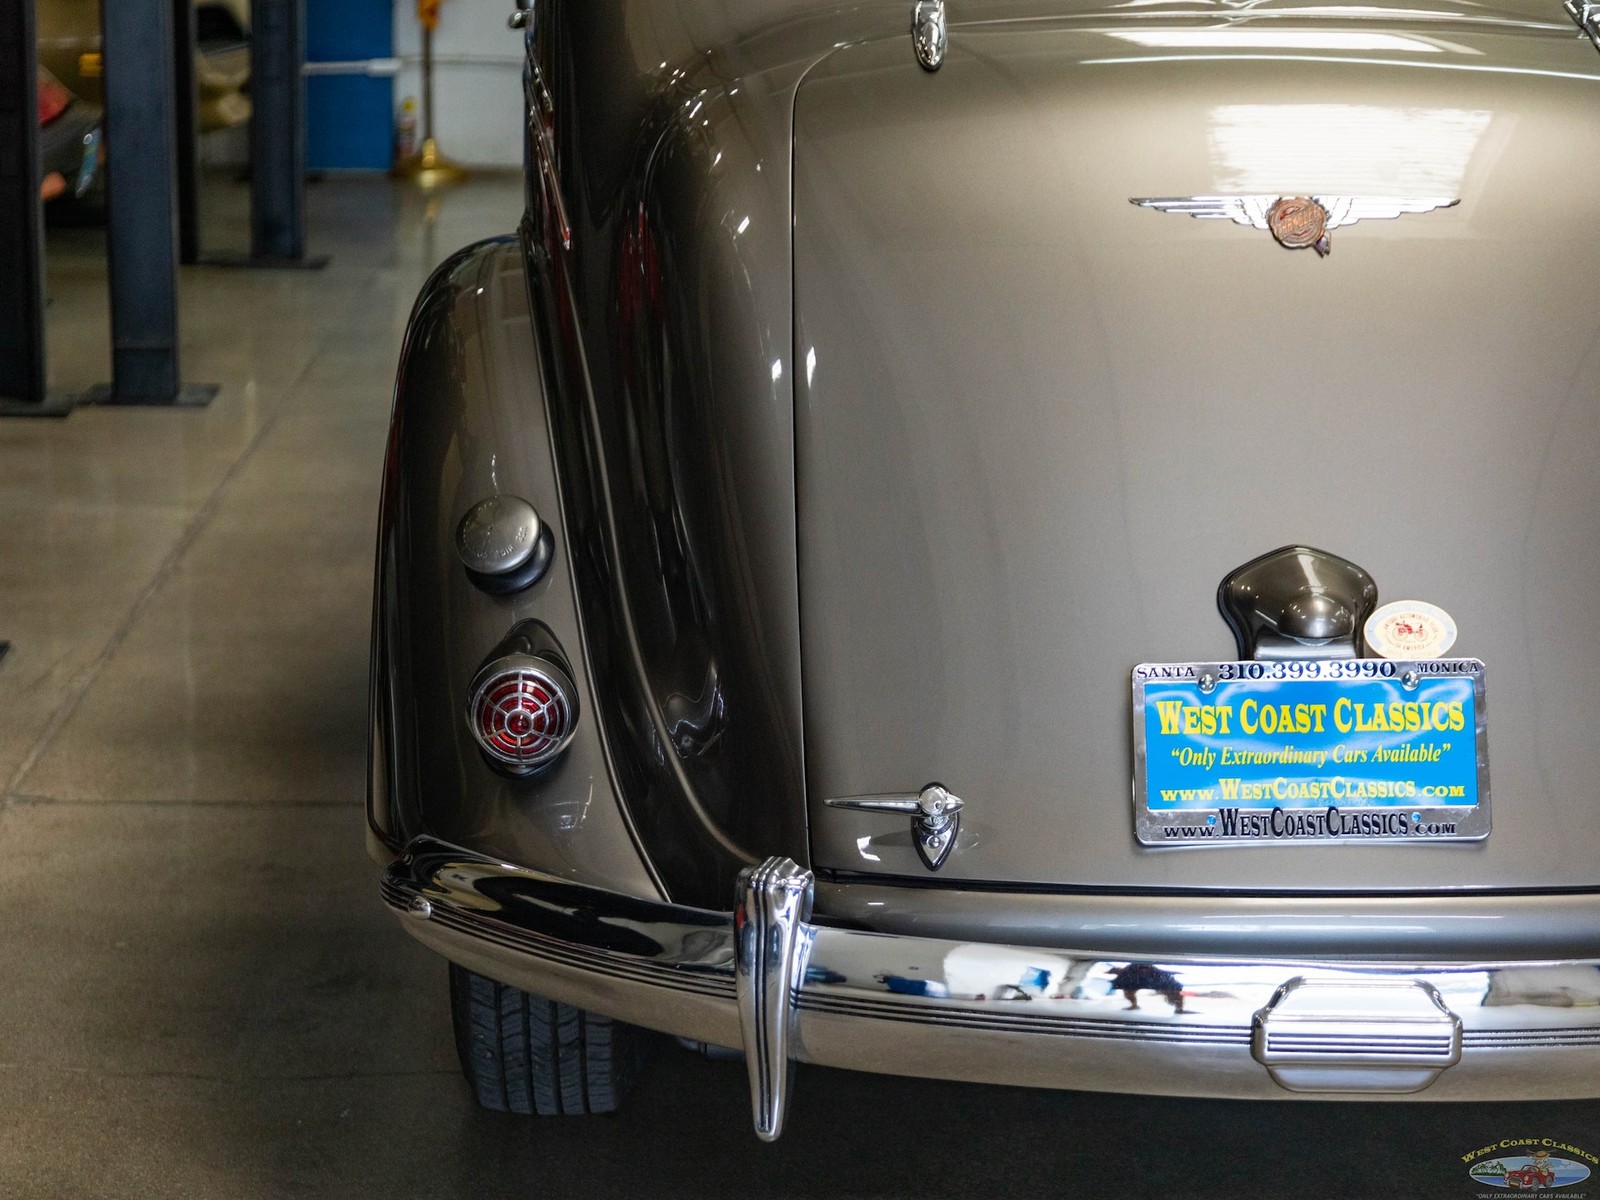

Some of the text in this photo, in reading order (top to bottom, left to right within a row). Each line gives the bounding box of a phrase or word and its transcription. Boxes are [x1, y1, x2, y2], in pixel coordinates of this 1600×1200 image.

[1137, 661, 1479, 680] SANTA 310.399.3990 MONICA
[1155, 697, 1465, 735] WEST COAST CLASSICS
[1171, 743, 1451, 771] “Only Extraordinary Cars Available”
